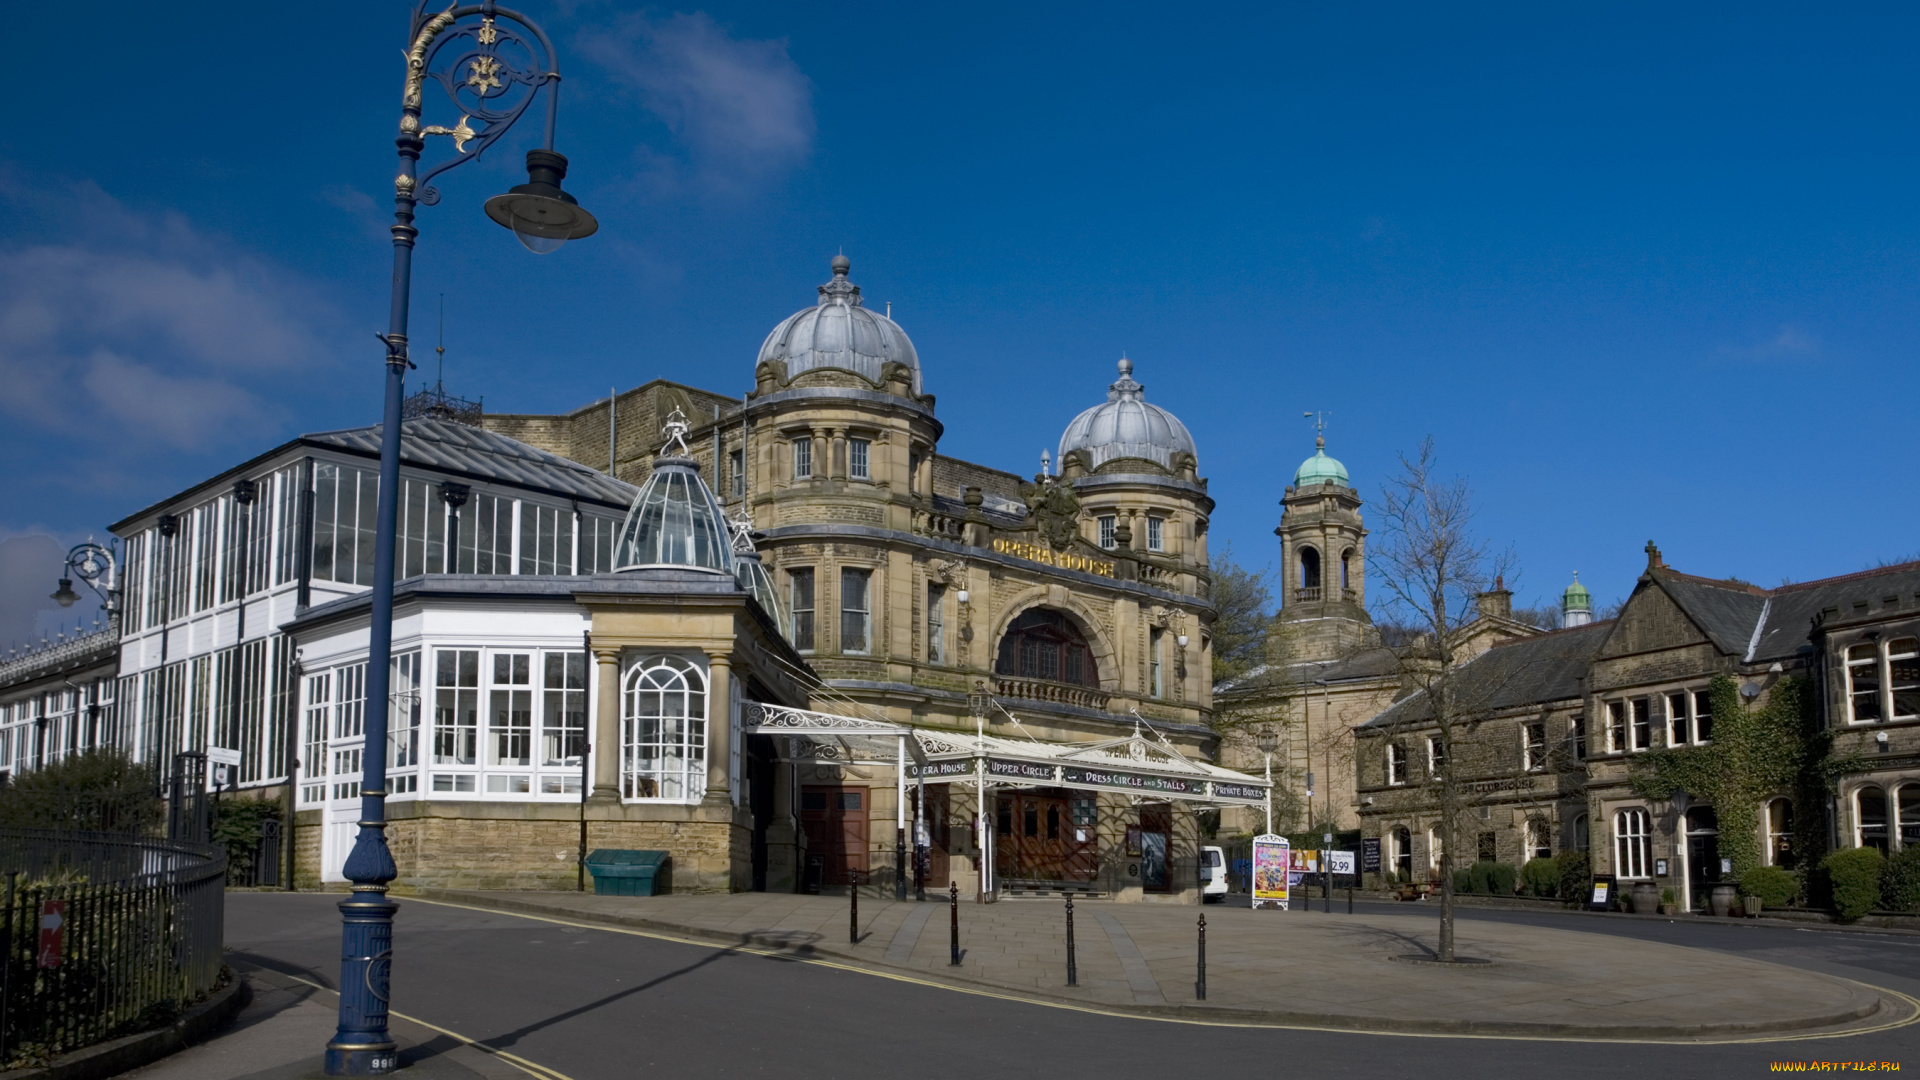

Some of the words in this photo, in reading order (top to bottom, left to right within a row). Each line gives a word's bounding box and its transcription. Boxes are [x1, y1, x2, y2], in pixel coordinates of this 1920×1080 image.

[993, 538, 1053, 565] OPERA
[1059, 552, 1115, 579] HOUSE
[1105, 743, 1132, 759] OPERA
[1144, 746, 1170, 764] HOUSE
[912, 765, 939, 776] OERA
[940, 763, 967, 773] HOUSE
[991, 762, 1019, 774] UPPER
[1021, 764, 1050, 777] CIRCLE
[1085, 771, 1112, 784] DRESS
[1113, 774, 1142, 787] CIRCLE
[1156, 779, 1186, 791] STALLS
[1215, 785, 1241, 796] PRIVATE
[1242, 787, 1263, 797] BOXES
